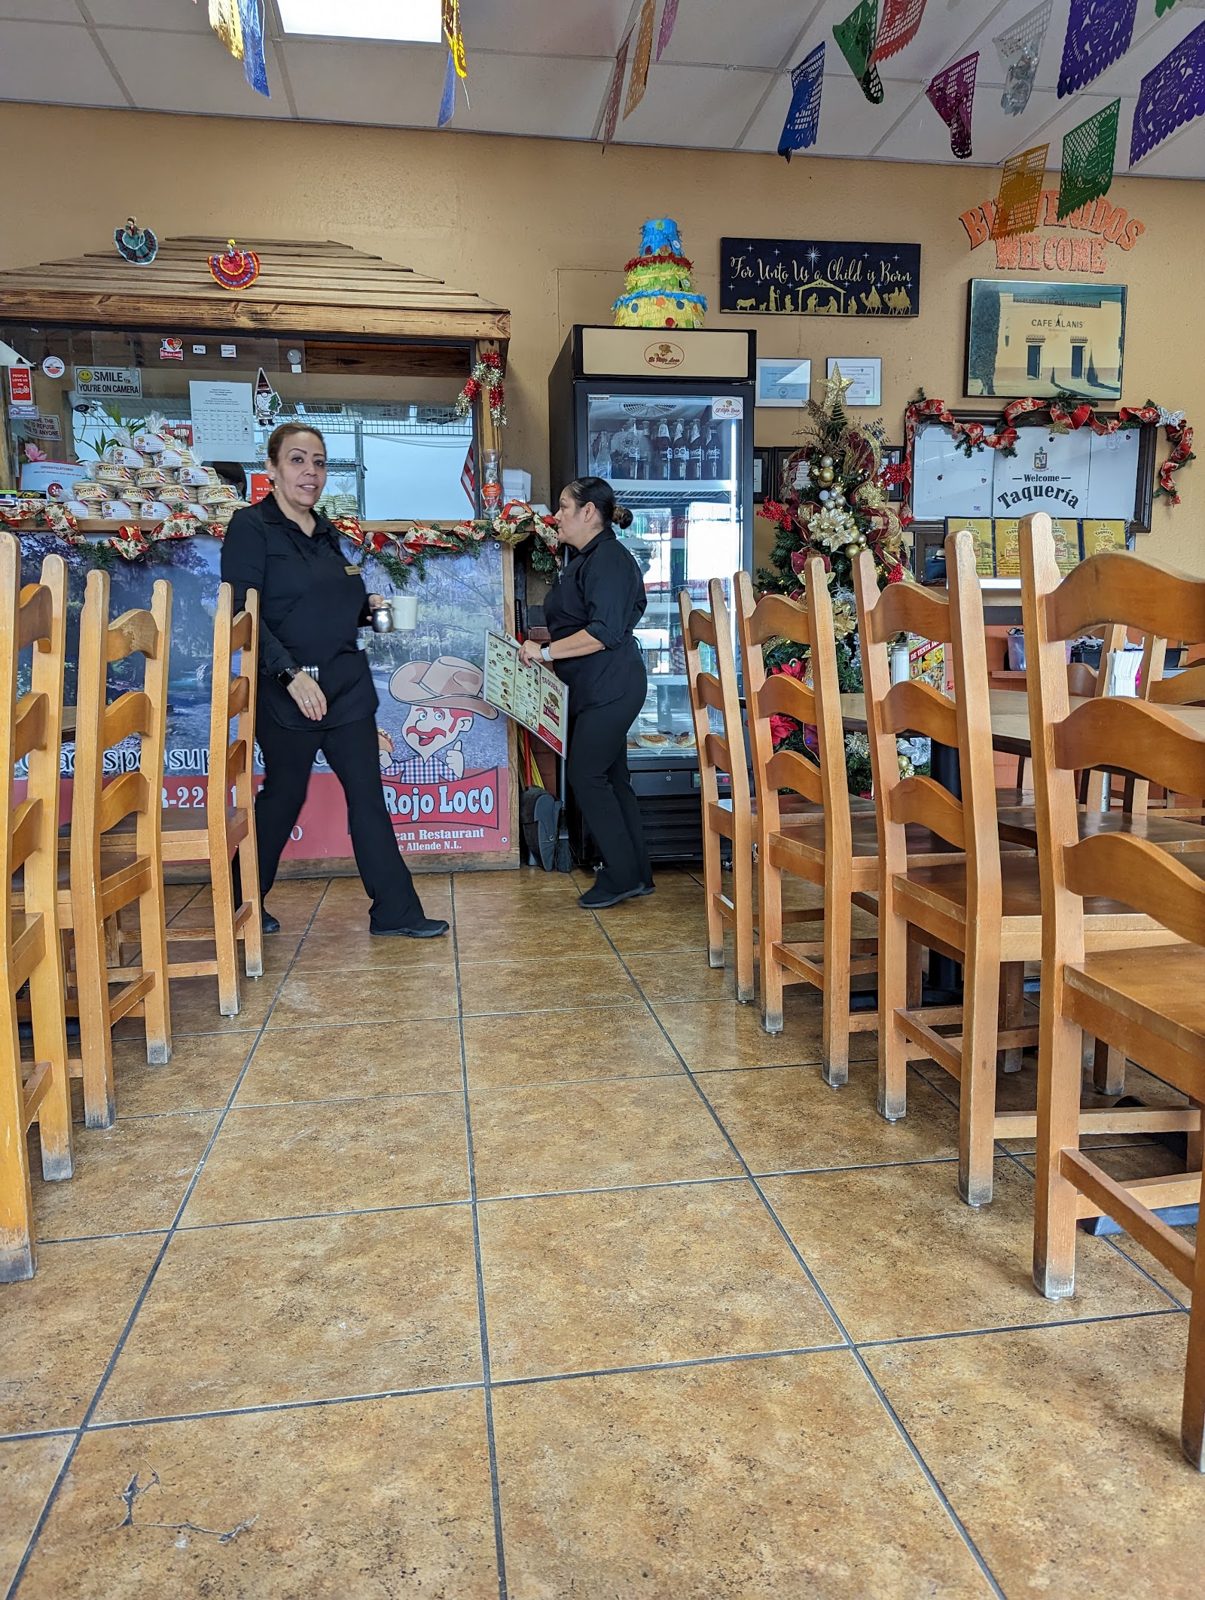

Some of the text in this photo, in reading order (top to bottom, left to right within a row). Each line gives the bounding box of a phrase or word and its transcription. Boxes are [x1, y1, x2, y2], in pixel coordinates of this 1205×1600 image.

[995, 235, 1108, 274] WELCOME
[730, 255, 912, 286] For Unto Us a Child is Born
[1031, 319, 1083, 329] CAFE ALANIS
[79, 384, 101, 392] YOU'RE
[1024, 474, 1060, 482] Welcome
[997, 485, 1080, 509] Taquería
[169, 748, 200, 770] su
[383, 785, 435, 822] Rojo
[418, 827, 485, 841] Restaurant
[406, 842, 442, 852] Allende
[443, 841, 462, 850] N.L.
